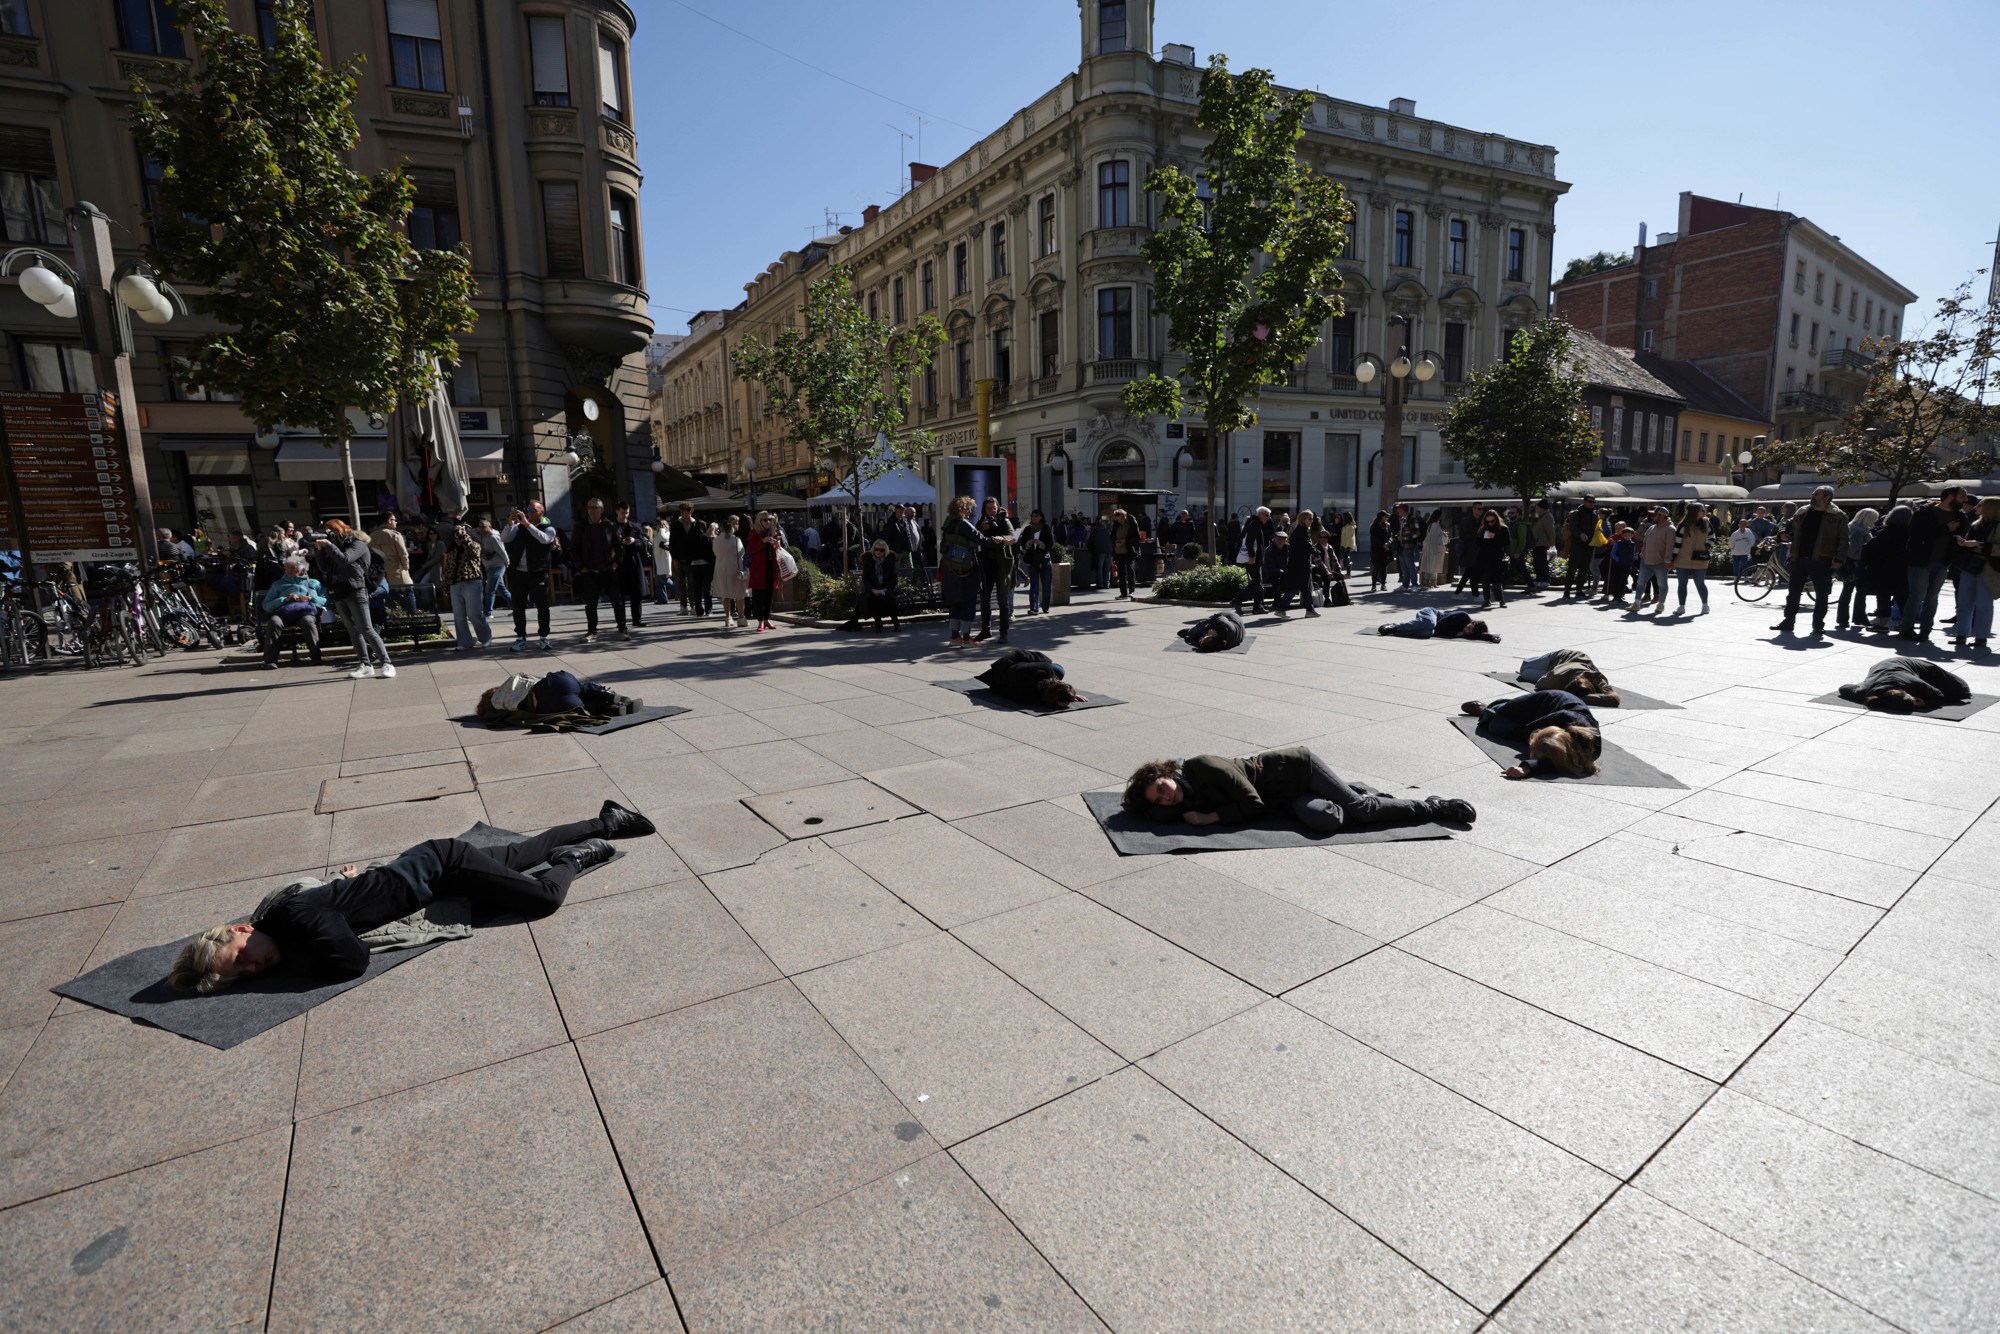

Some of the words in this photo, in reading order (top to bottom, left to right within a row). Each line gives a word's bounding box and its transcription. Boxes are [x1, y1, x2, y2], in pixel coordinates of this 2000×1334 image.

[1329, 408, 1366, 420] UNITED
[5, 418, 26, 426] Muzej
[945, 427, 978, 445] BENETTO
